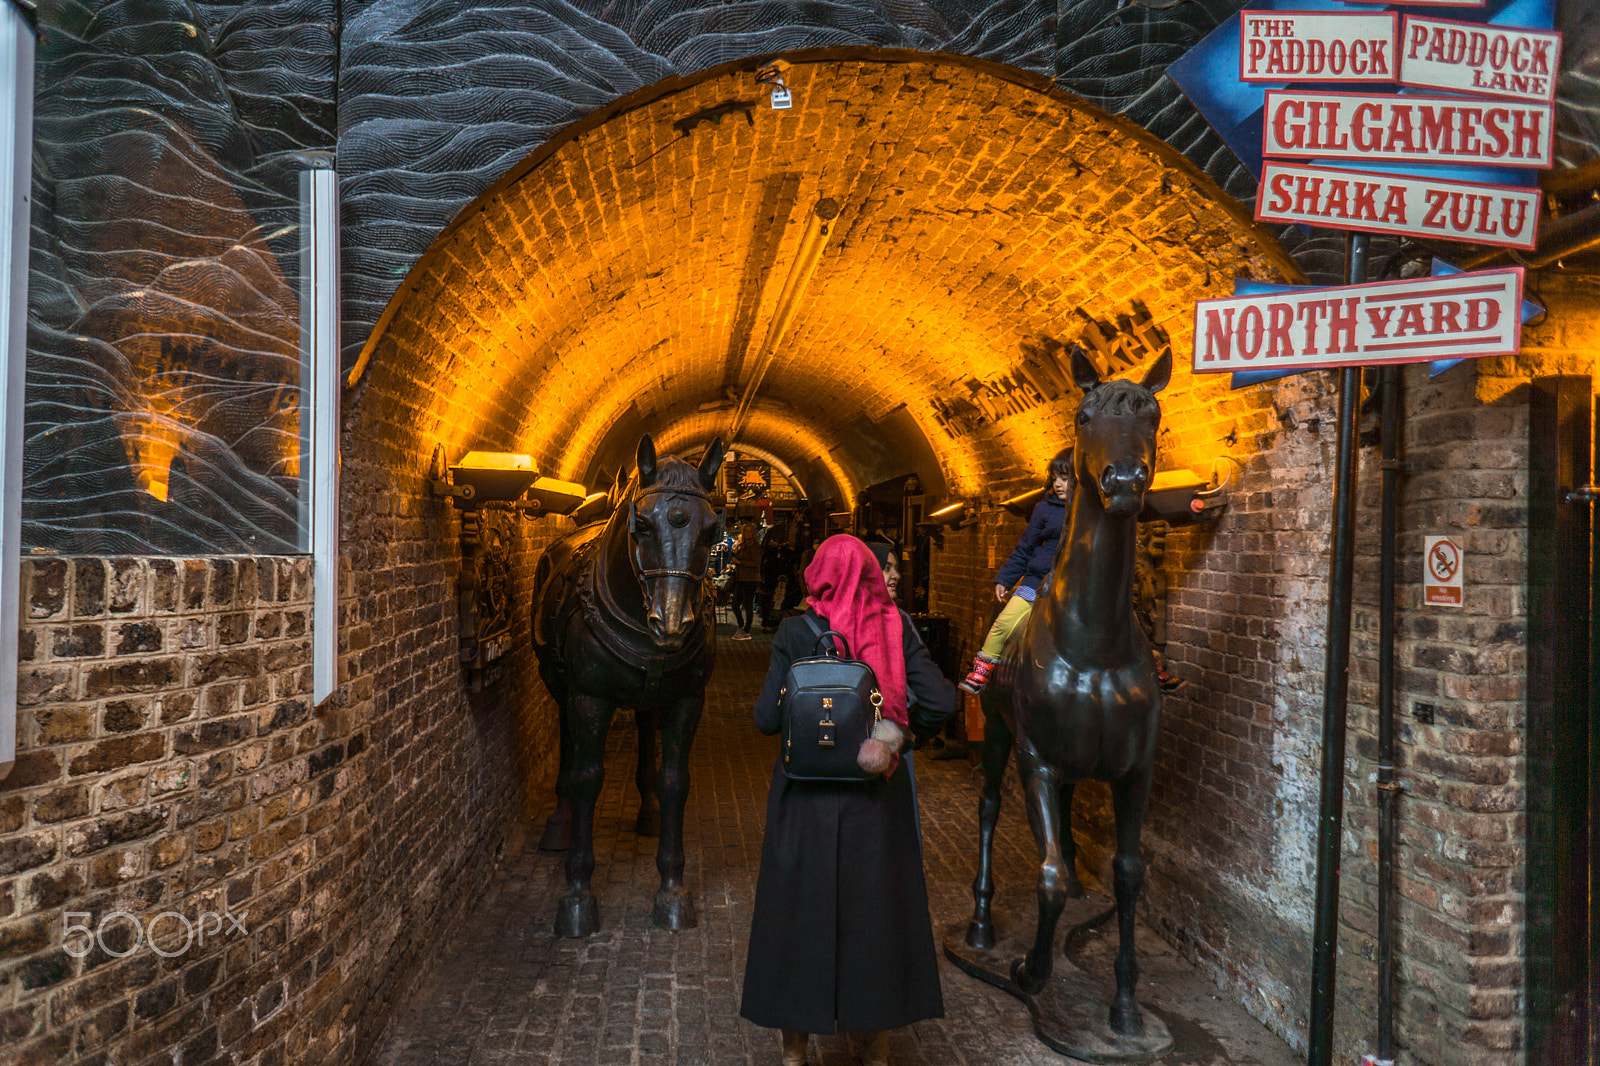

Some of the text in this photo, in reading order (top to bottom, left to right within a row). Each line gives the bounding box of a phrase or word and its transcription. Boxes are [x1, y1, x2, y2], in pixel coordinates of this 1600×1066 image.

[1248, 19, 1295, 38] THE
[1407, 24, 1553, 75] PADDOCK
[1247, 38, 1390, 76] PADDOCK
[1471, 69, 1548, 96] LANE
[1271, 99, 1544, 160] GILGAMESH
[1267, 173, 1530, 238] SHAKA ZULU
[1202, 296, 1502, 363] NORTH YARD
